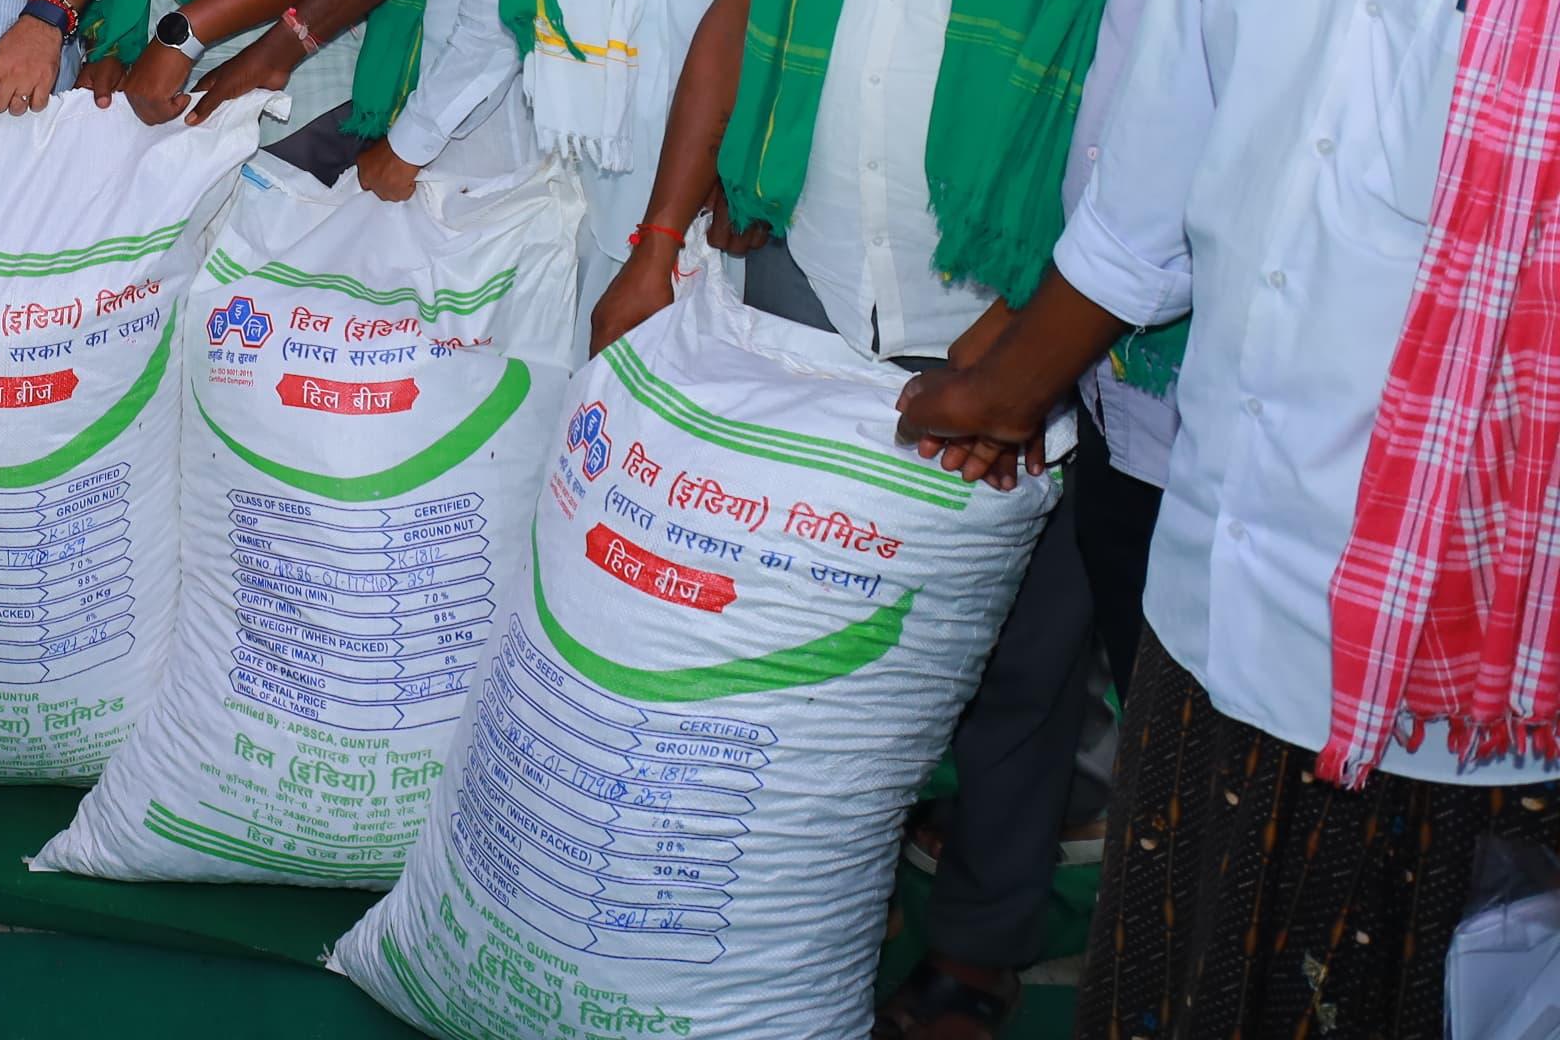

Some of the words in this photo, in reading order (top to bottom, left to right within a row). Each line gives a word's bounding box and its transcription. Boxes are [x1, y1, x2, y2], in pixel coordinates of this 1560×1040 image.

[1, 297, 84, 337] (इंडिया)
[95, 277, 164, 317] लिमिटेड
[234, 303, 246, 320] इ
[214, 314, 225, 336] हि
[247, 318, 264, 338] लि
[289, 306, 333, 333] हिल
[10, 339, 74, 362] सरकार
[84, 329, 110, 348] का
[117, 307, 160, 338] उद्यम)
[282, 336, 338, 364] (भारत
[348, 344, 417, 367] सरकार
[15, 380, 55, 403] बीज
[302, 379, 340, 409] हिल
[352, 386, 394, 411] बीज
[67, 468, 120, 494] CERTIFIED
[56, 495, 100, 518] GROUND
[102, 486, 121, 501] NUT
[235, 494, 263, 508] CLASS
[264, 500, 276, 510] OF
[278, 503, 312, 516] SEEDS
[414, 498, 471, 518] CERTIFIED
[622, 442, 663, 488] हिल
[667, 471, 770, 533] (इंडिया)
[784, 501, 904, 560] लिमिटेड
[235, 513, 259, 527] CROP
[403, 524, 452, 542] GROUND
[454, 518, 475, 533] NUT
[605, 484, 657, 531] (भारत
[666, 521, 744, 562] सरकार
[759, 549, 794, 572] का
[236, 534, 273, 551] VARIETY
[238, 554, 255, 566] LOT
[256, 561, 273, 572] NO.
[602, 538, 645, 582] हिल
[655, 568, 705, 603] बीज
[78, 574, 99, 588] 98%
[240, 572, 303, 597] GERMINATION
[305, 590, 335, 606] (MIN.)
[80, 595, 93, 606] 30
[95, 588, 111, 599] Kg
[241, 592, 274, 608] PURITY
[275, 601, 302, 618] (MIN.)
[423, 591, 449, 605] 70%
[433, 610, 457, 624] 98%
[240, 612, 258, 625] NET
[260, 618, 300, 636] WEIGHT
[301, 629, 337, 648] (WHEN
[339, 639, 389, 655] PACKED)
[437, 633, 452, 645] 30
[455, 630, 473, 641] Kg
[291, 648, 324, 666] (MAX.)
[444, 655, 458, 666] 8%
[238, 650, 264, 668] DATE
[265, 662, 279, 673] OF
[280, 666, 327, 689] PACKING
[237, 671, 259, 687] MAX.
[262, 679, 295, 700] RETAIL
[297, 693, 327, 710] PRICE
[237, 682, 259, 697] (INCL.
[259, 690, 271, 700] OF
[272, 696, 287, 708] ALL
[290, 703, 319, 721] TAXES)
[223, 697, 265, 721] Certified
[266, 714, 280, 729] By
[287, 722, 337, 747] APSSCA,
[340, 736, 390, 750] GUNTUR
[679, 720, 759, 742] CERTIFIED
[235, 732, 276, 768] हिल
[289, 755, 376, 797] (इंडिया)
[391, 761, 444, 790] लिमि
[296, 741, 350, 765] उत्पादक
[359, 752, 378, 768] एवं
[386, 749, 432, 765] विपणन
[655, 741, 720, 758] GROUND
[722, 748, 753, 764] NUT
[247, 825, 275, 847] हिल
[283, 839, 297, 852] के
[656, 840, 686, 853] 98%
[653, 865, 673, 877] 30
[677, 866, 700, 879] Kg
